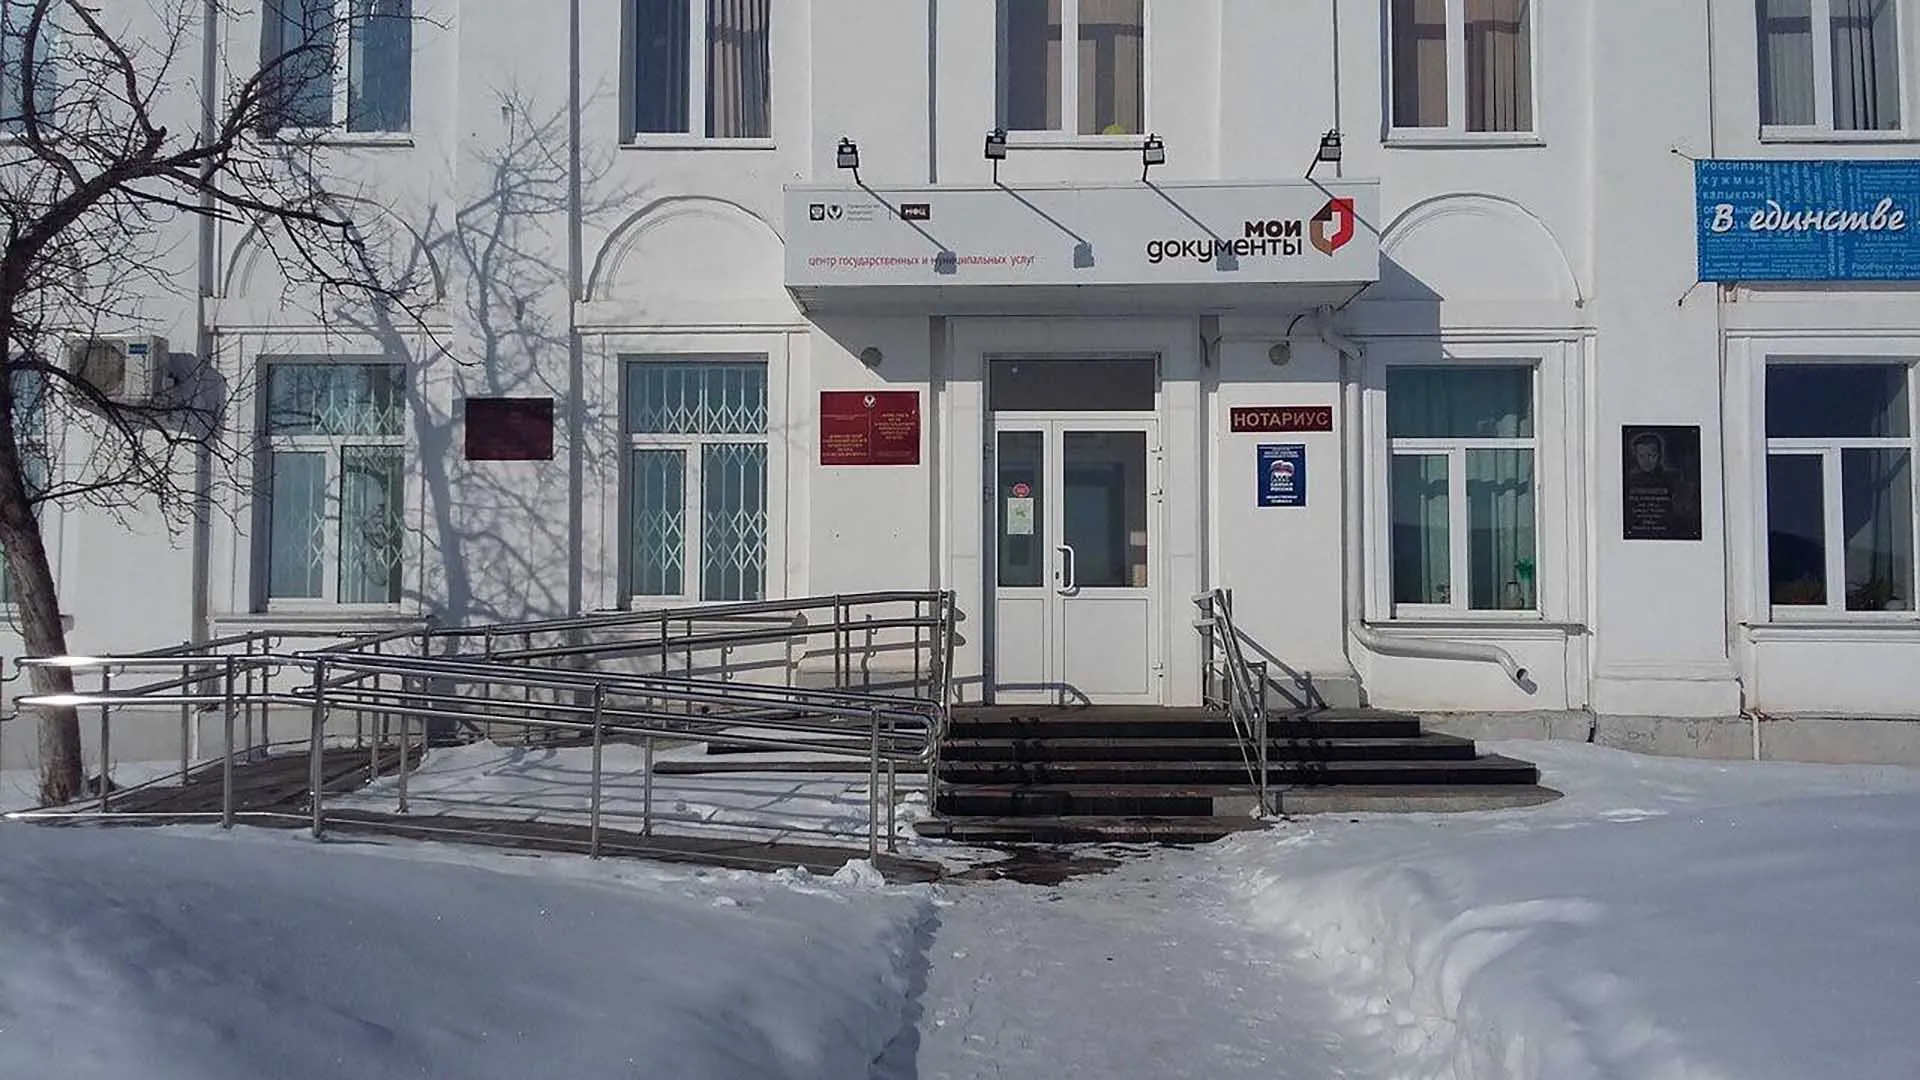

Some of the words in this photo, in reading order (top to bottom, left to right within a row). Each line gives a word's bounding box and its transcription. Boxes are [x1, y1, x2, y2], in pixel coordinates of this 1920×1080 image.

[1711, 203, 1734, 232] В
[1750, 198, 1905, 232] единстве
[1245, 220, 1302, 238] мои
[1147, 238, 1302, 264] документы
[808, 257, 837, 266] центр
[839, 256, 919, 266] государственных
[930, 256, 1007, 266] муниципальных
[1010, 256, 1035, 266] услуг
[1234, 412, 1328, 427] НОТАРИУС
